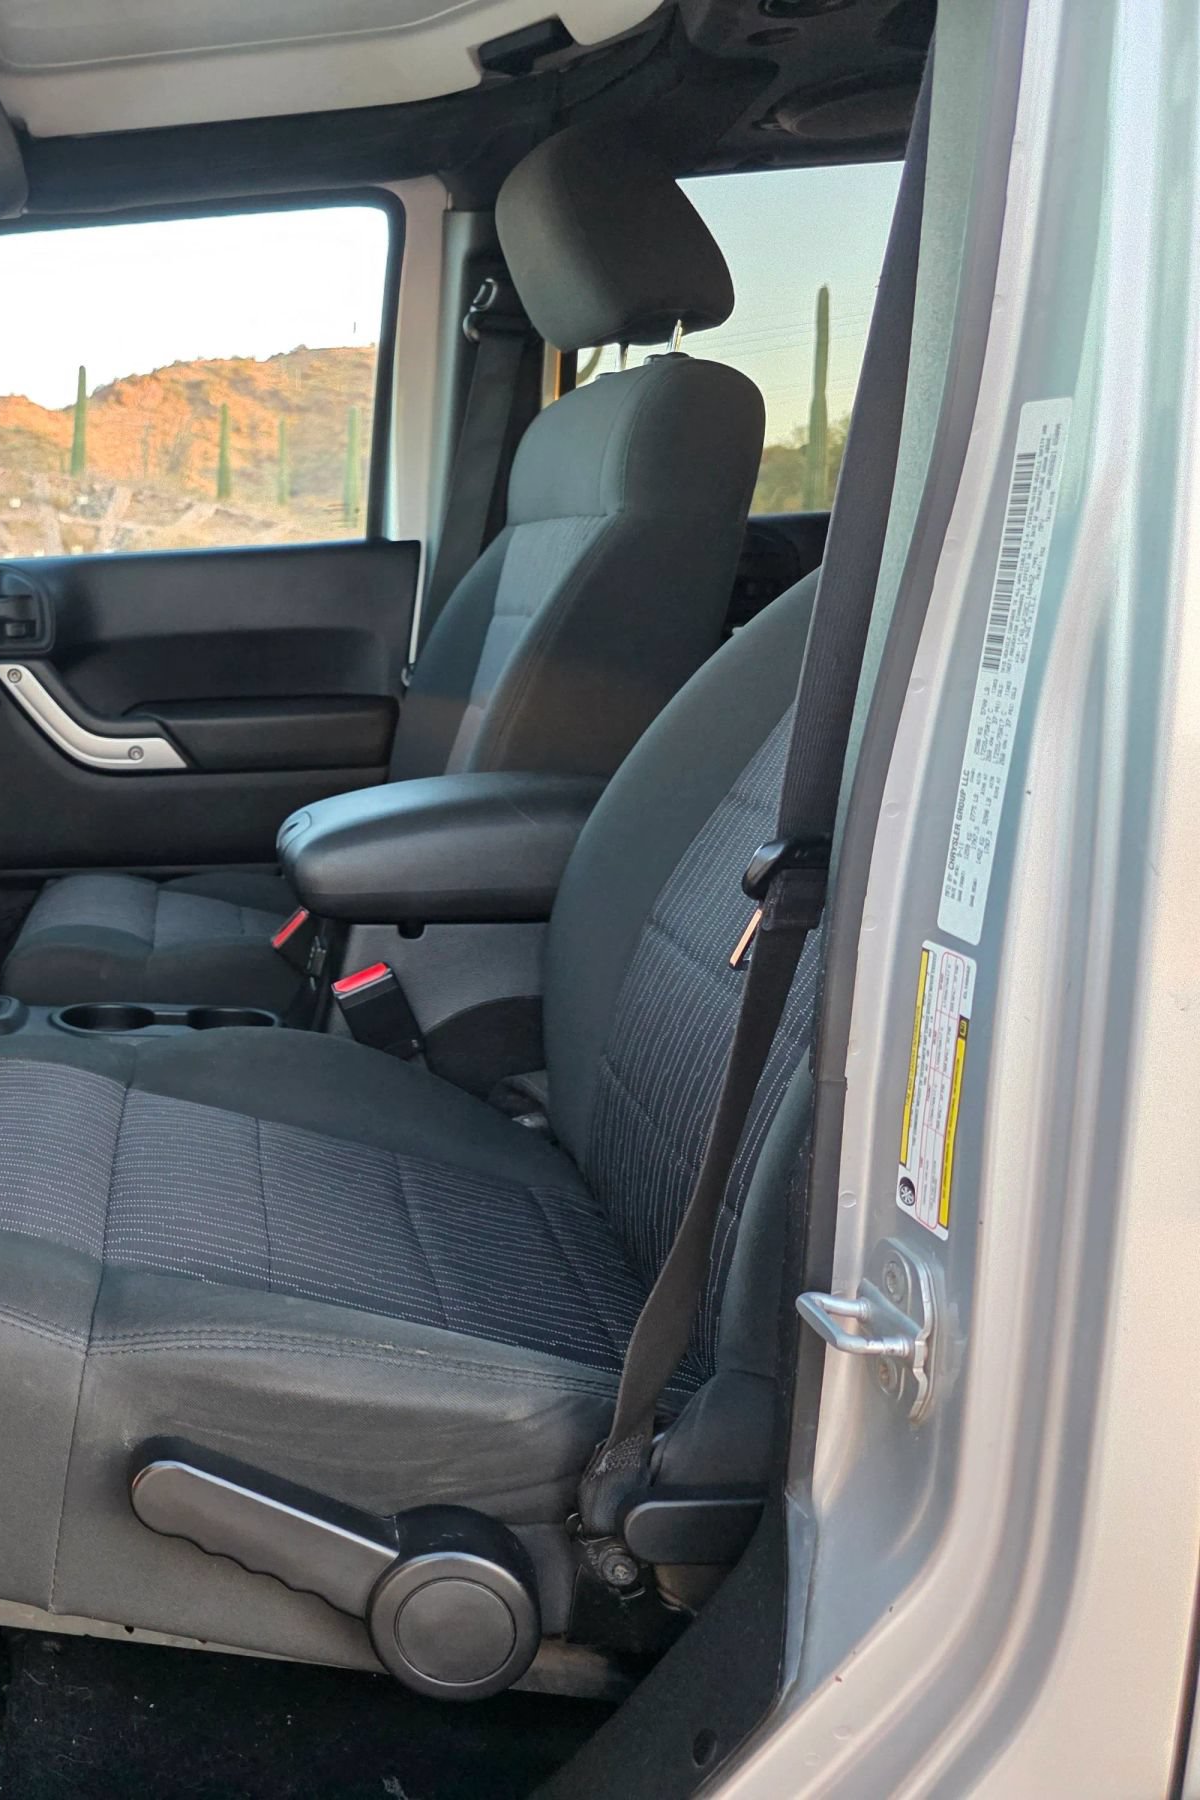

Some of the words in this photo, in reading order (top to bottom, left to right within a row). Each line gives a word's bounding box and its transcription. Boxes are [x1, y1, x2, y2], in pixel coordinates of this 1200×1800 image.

[948, 824, 961, 870] CHRYSLER
[956, 788, 967, 820] GROUP
[962, 769, 970, 786] LLC
